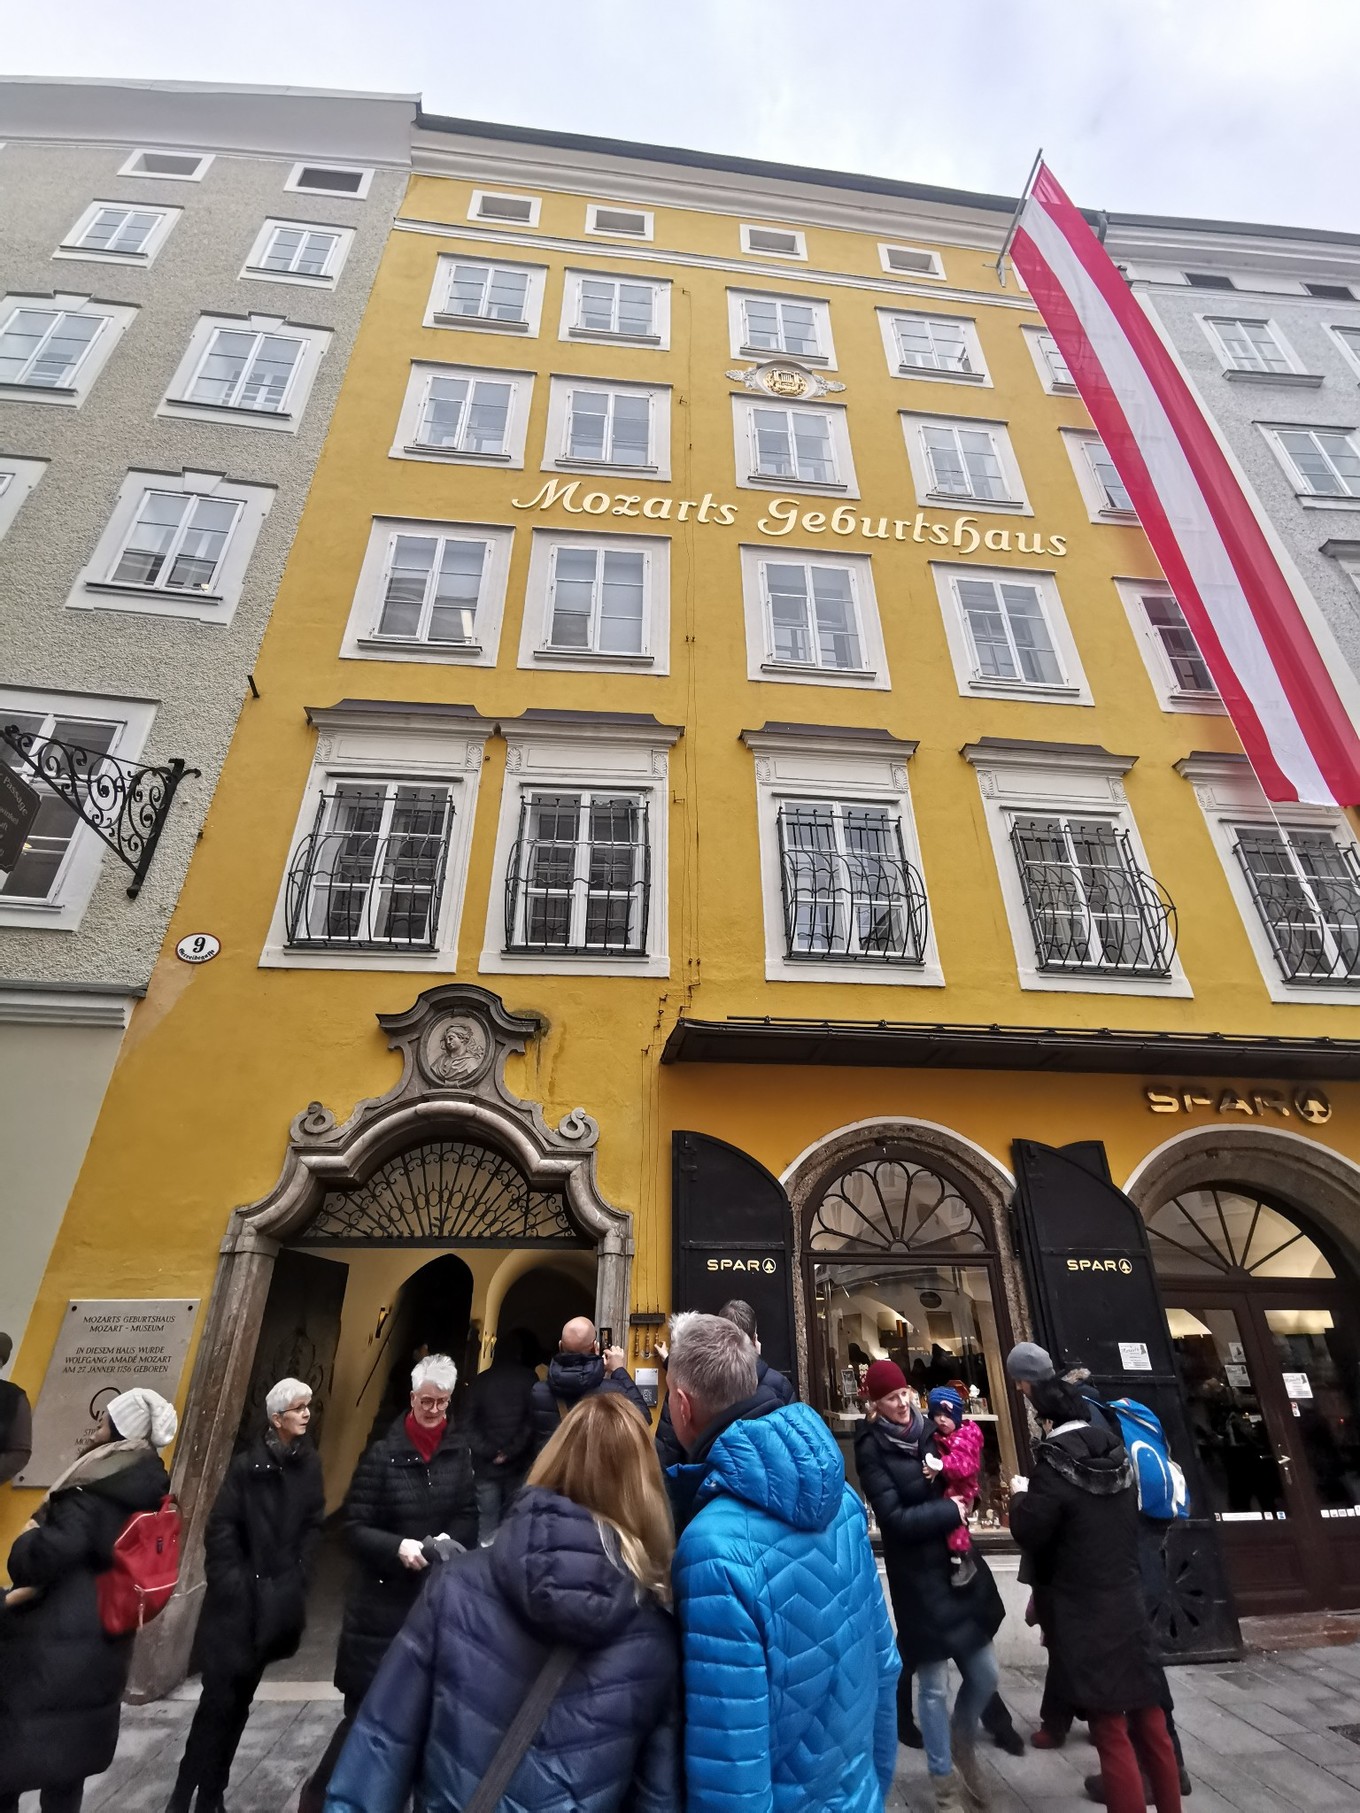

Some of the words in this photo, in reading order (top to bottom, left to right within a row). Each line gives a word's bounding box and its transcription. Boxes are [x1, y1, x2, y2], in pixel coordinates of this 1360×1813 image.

[511, 478, 739, 526] Mozarts
[757, 497, 1068, 557] Geburtshaus
[3, 776, 28, 816] Passage
[193, 937, 206, 953] 9
[1147, 1090, 1290, 1117] SPAR
[706, 1259, 760, 1272] SPAR
[1066, 1259, 1118, 1272] SPAR
[83, 1315, 121, 1323] MOZARTS
[123, 1315, 176, 1323] GEBURTSHAUS
[76, 1346, 85, 1354] IN
[85, 1346, 114, 1354] DIESEM
[115, 1346, 136, 1354] HAUS
[138, 1346, 165, 1354] WURDE
[65, 1356, 107, 1364] WOLFGANG
[108, 1355, 137, 1364] AMADÉ
[138, 1355, 172, 1363] MOZART
[117, 1365, 132, 1373] 1756
[133, 1365, 168, 1373] GEBOREN
